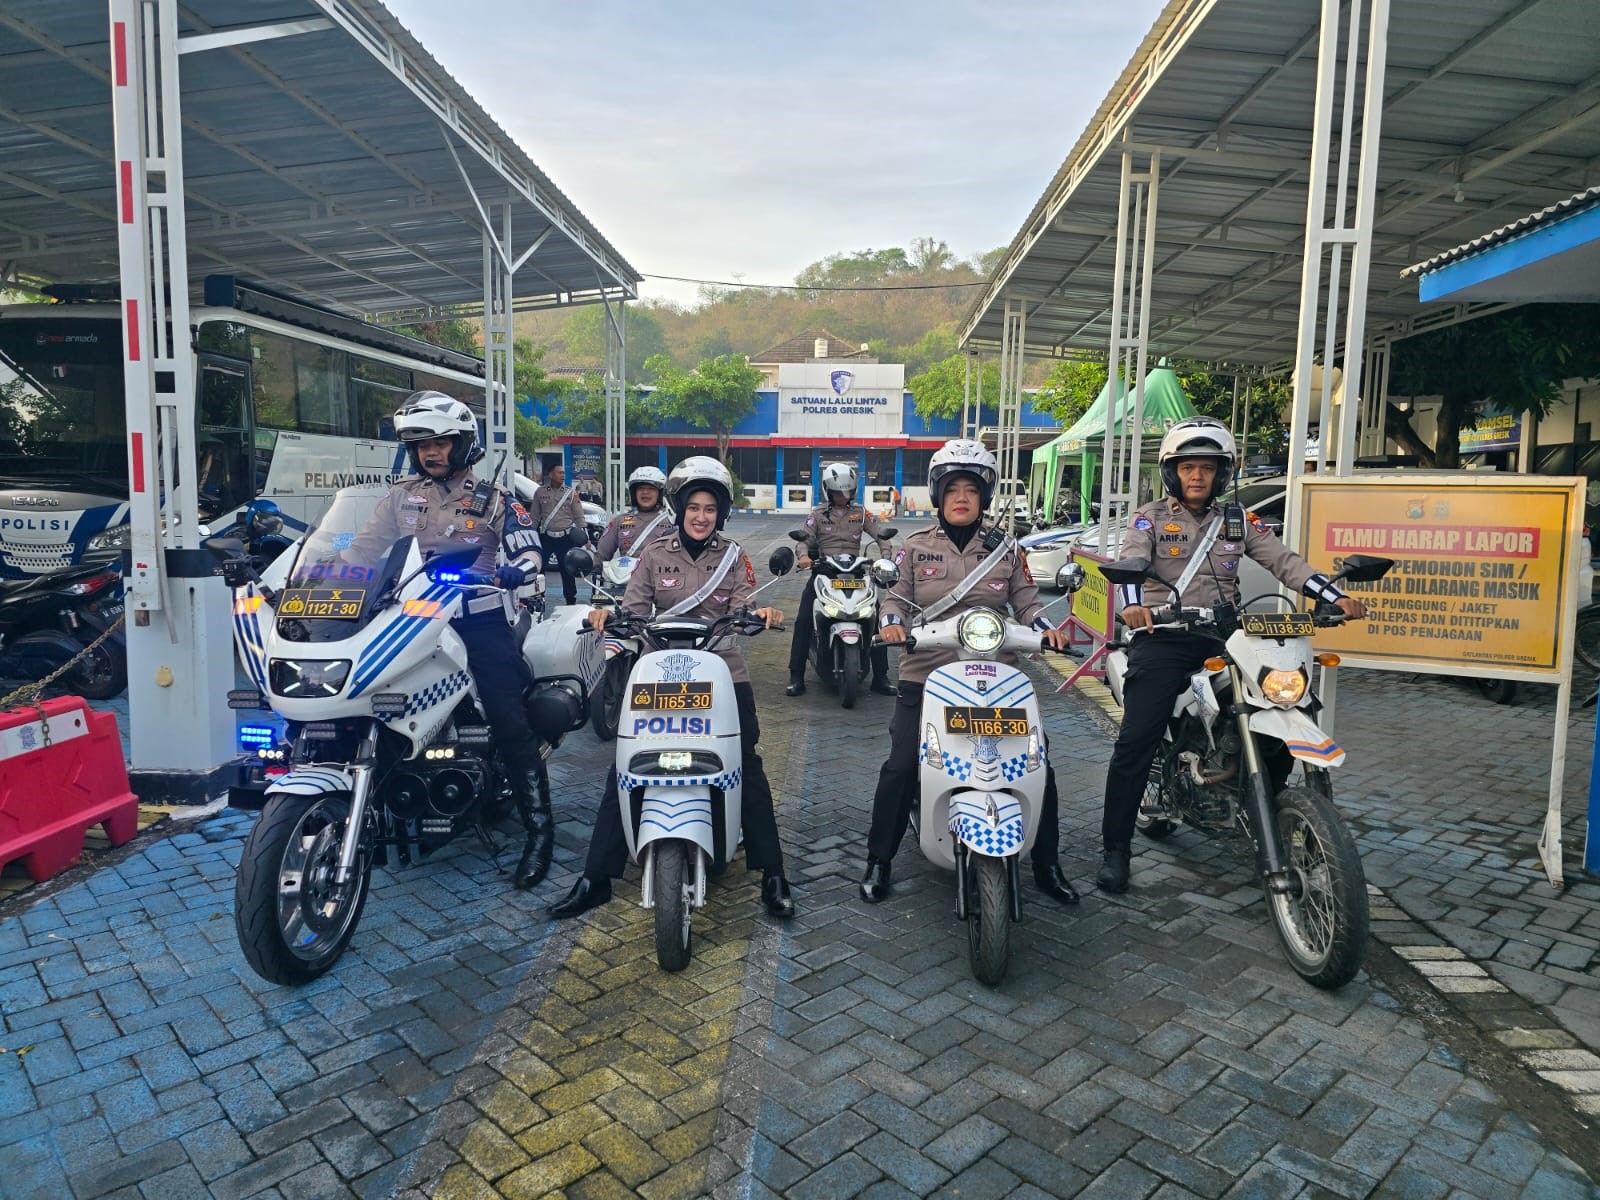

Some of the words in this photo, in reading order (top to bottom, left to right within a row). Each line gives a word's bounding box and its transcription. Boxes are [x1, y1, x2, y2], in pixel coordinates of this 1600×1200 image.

[65, 332, 98, 343] armada
[791, 396, 827, 405] SATUAN
[829, 397, 853, 405] LALU
[855, 397, 888, 406] LINTAS
[802, 406, 837, 414] POLRES
[840, 406, 874, 414] GRESIK
[304, 472, 381, 489] PELAYANAN
[11, 496, 60, 506] ISUZU
[1, 518, 69, 531] POLISI
[1160, 534, 1188, 542] ARIF.H
[1332, 527, 1386, 549] TAMU
[1391, 529, 1460, 551] HARAP
[1464, 530, 1534, 553] LAPOR
[917, 553, 944, 562] DINI
[294, 562, 376, 584] POLISI
[658, 566, 680, 574] IKA
[1392, 559, 1475, 577] PEMOHON
[1480, 562, 1515, 579] SIM
[1518, 563, 1529, 580] /
[330, 590, 343, 600] X
[1406, 577, 1480, 597] DILARANG
[1484, 581, 1540, 601] MASUK
[307, 603, 358, 615] 1121-30
[1382, 598, 1447, 612] PUNGGUNG
[1459, 602, 1498, 615] JAKET
[1284, 614, 1292, 622] X
[1369, 611, 1417, 624] DILEPAS
[1421, 613, 1446, 625] DAN
[1450, 615, 1519, 630] DITITIPKAN
[1367, 624, 1379, 634] DI
[1383, 625, 1407, 637] POS
[1410, 626, 1482, 641] PENJAGAAN
[965, 664, 997, 673] POLISI
[681, 682, 688, 694] X
[658, 695, 710, 709] 1165-30
[994, 708, 1002, 719] X
[633, 716, 712, 736] POLISI
[973, 721, 1027, 734] 1166-30
